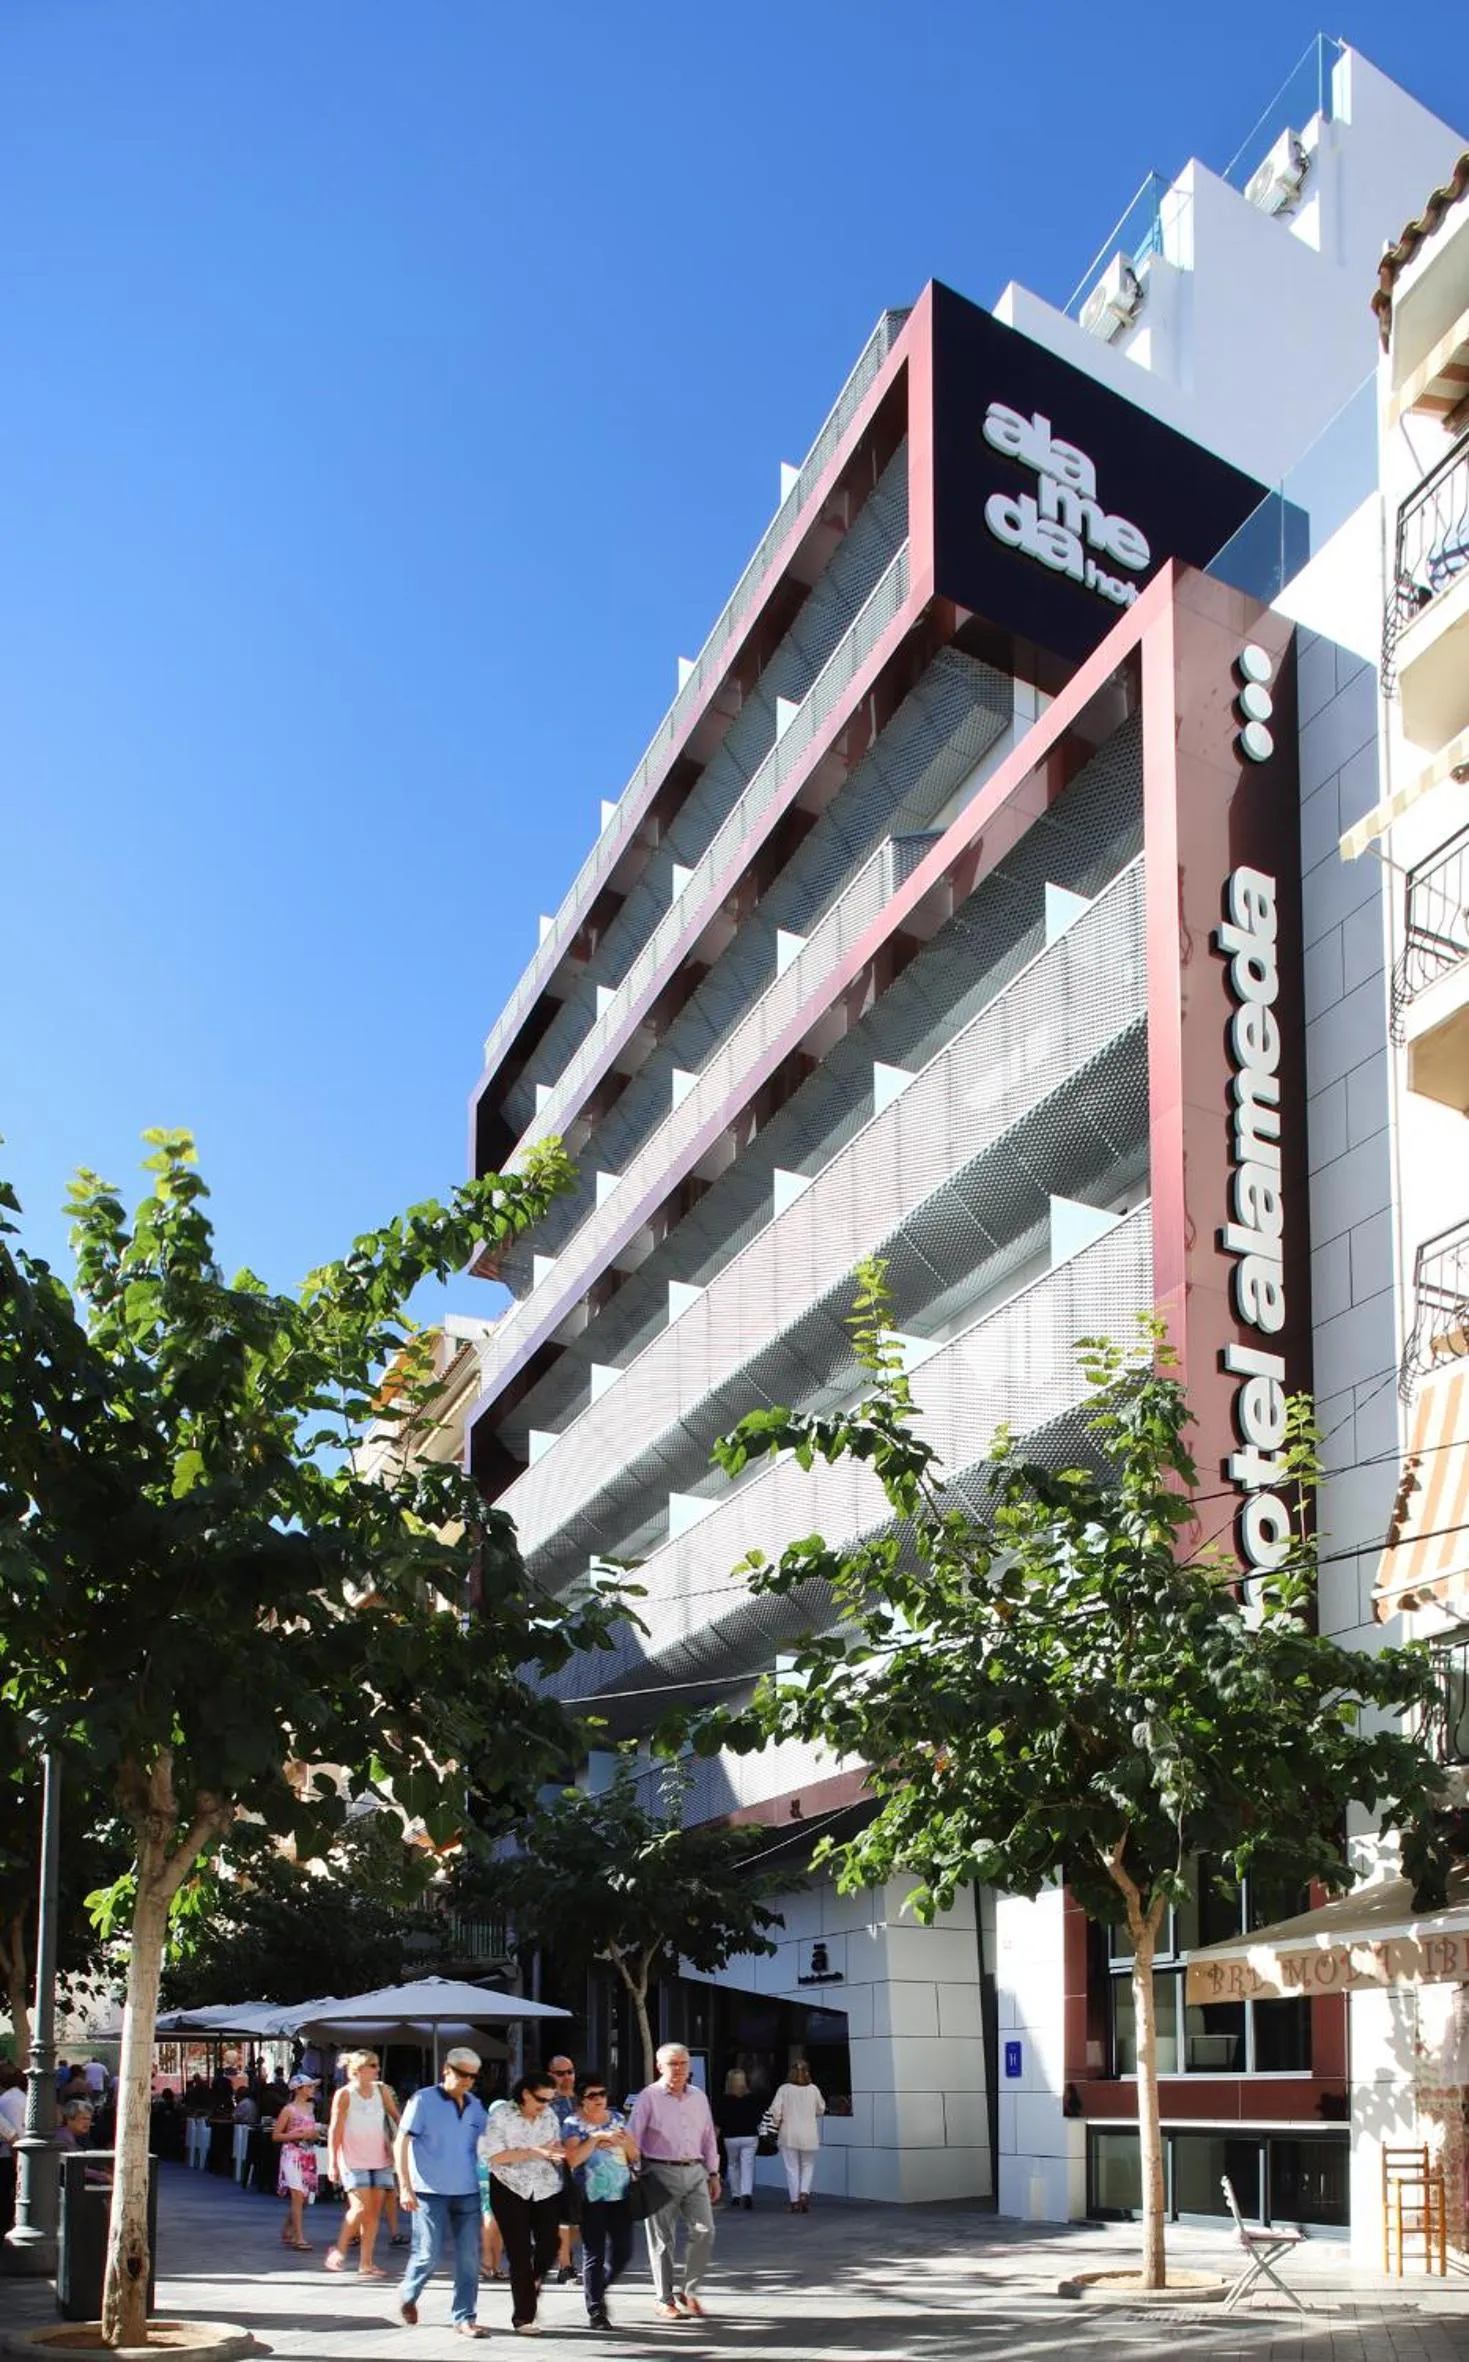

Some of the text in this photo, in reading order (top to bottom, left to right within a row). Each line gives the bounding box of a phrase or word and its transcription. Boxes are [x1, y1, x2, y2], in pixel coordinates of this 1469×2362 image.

[982, 401, 1098, 501] ala
[984, 493, 1084, 584] da
[1038, 471, 1150, 571] me
[1217, 865, 1286, 1333] alameda
